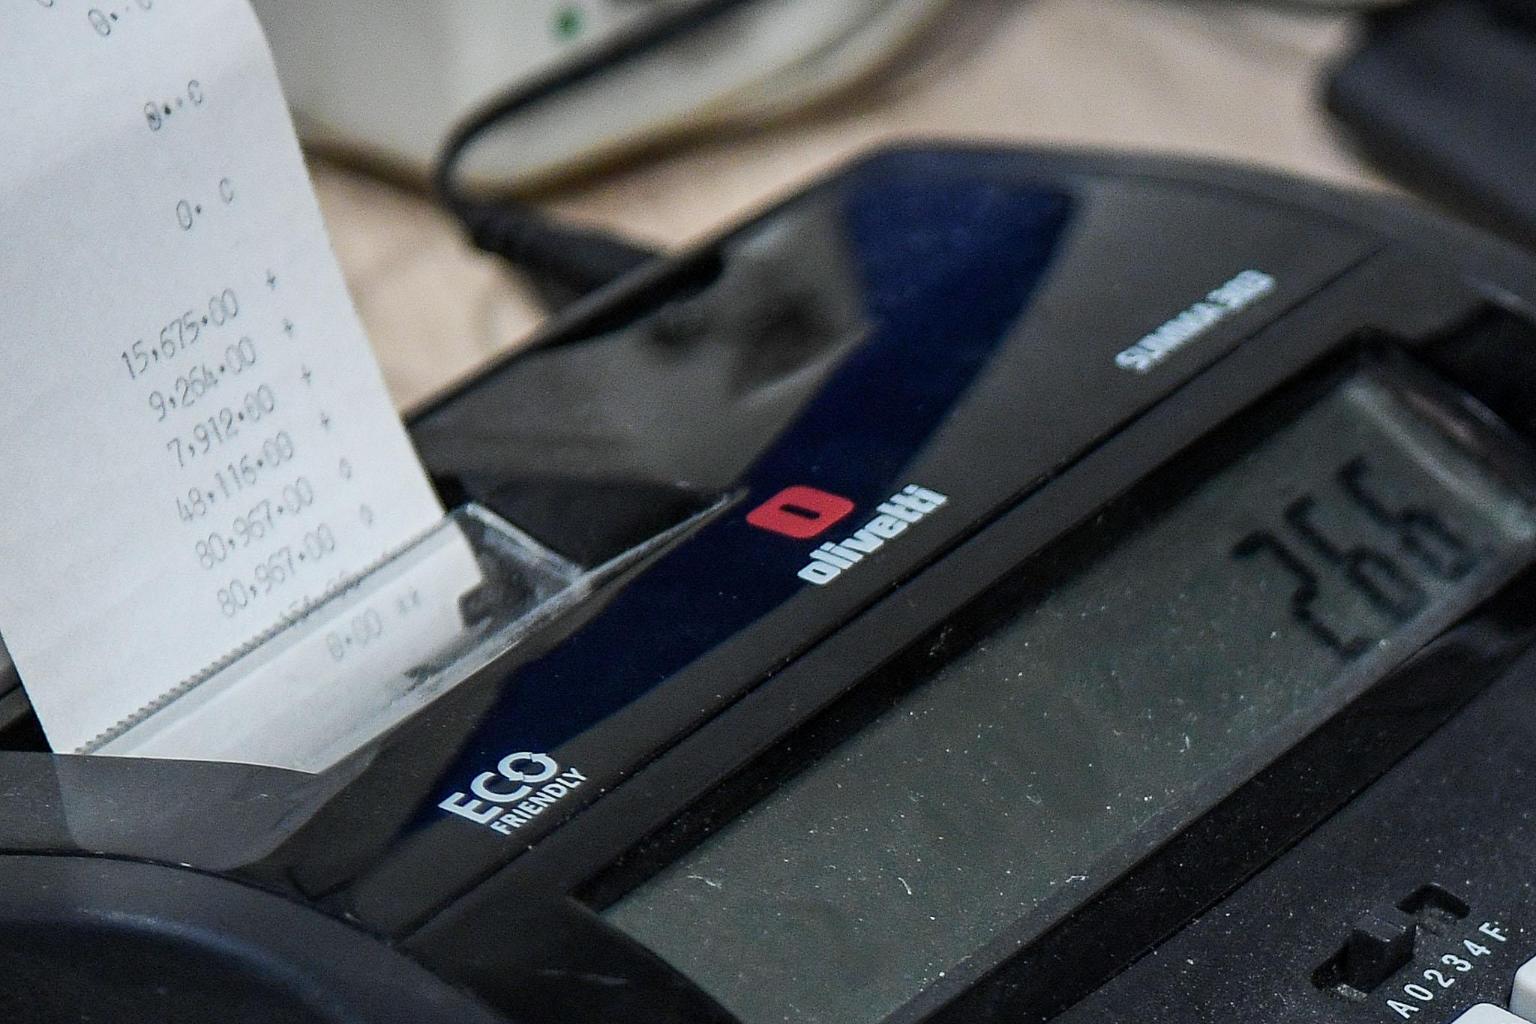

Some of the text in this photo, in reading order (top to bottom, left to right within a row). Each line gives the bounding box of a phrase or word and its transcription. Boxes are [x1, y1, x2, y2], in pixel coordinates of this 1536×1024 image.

[797, 483, 948, 585] olivetti
[438, 752, 558, 824] ECO
[490, 767, 588, 835] FRIENDLY
